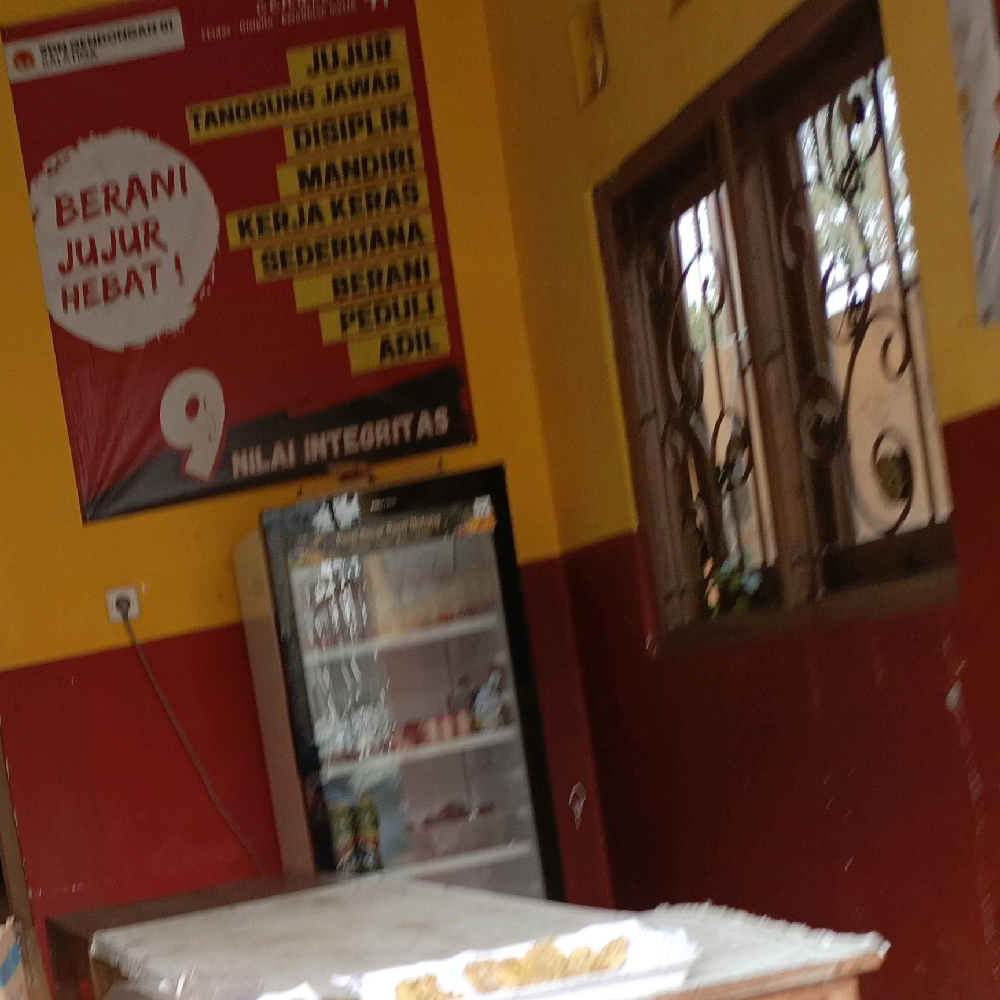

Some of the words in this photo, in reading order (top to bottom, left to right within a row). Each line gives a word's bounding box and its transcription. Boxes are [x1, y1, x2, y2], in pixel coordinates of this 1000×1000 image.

[306, 37, 394, 78] JUJUR
[192, 90, 315, 132] TANGGUNG
[320, 70, 400, 104] JAWAB
[293, 103, 410, 150] DISIPLIN
[297, 145, 416, 190] MANDIRI
[55, 163, 189, 231] BERANI
[237, 202, 324, 239] KERJA
[330, 183, 420, 220] KERAS
[57, 218, 168, 275] JUJUR
[260, 220, 425, 273] SEDERHANA
[60, 261, 160, 314] HEBAT
[331, 257, 431, 298] BERANI
[340, 295, 435, 333] PEDULI
[378, 329, 435, 362] ADIL
[160, 367, 226, 482] 9
[231, 440, 296, 480] NILAI
[303, 407, 450, 463] INTEGRITAS
